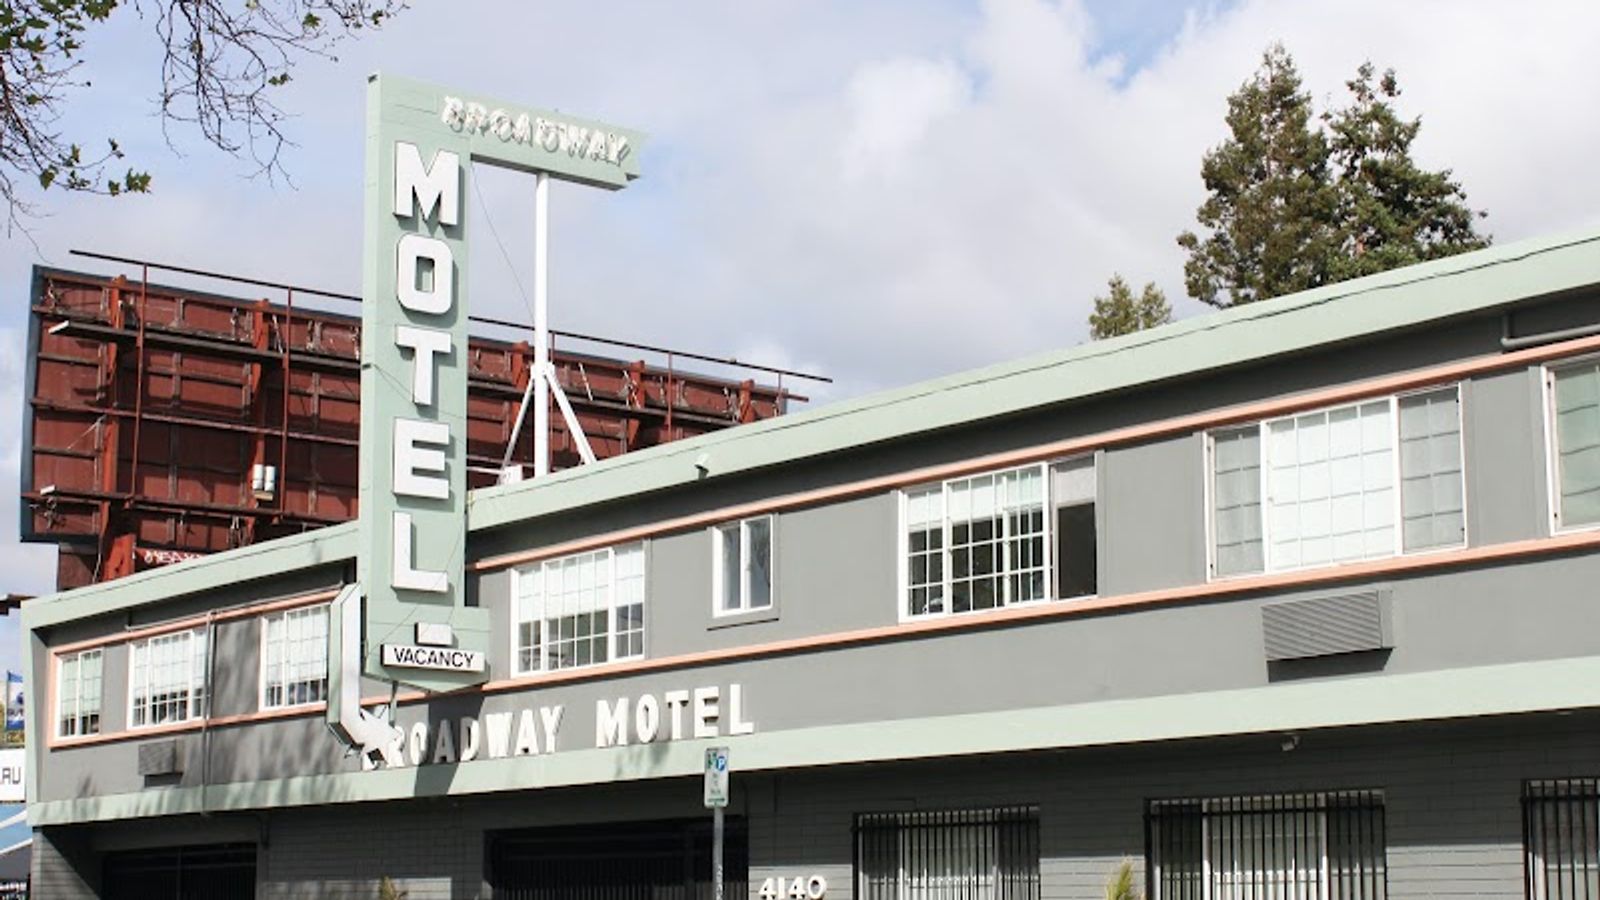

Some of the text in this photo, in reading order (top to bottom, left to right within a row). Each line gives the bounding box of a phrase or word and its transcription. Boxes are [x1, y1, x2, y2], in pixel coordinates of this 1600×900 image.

[441, 95, 629, 166] BROADWAY
[392, 140, 460, 592] MOTEL
[393, 646, 476, 670] VACANCY
[595, 684, 755, 749] MOTEL
[759, 875, 827, 900] 4140
